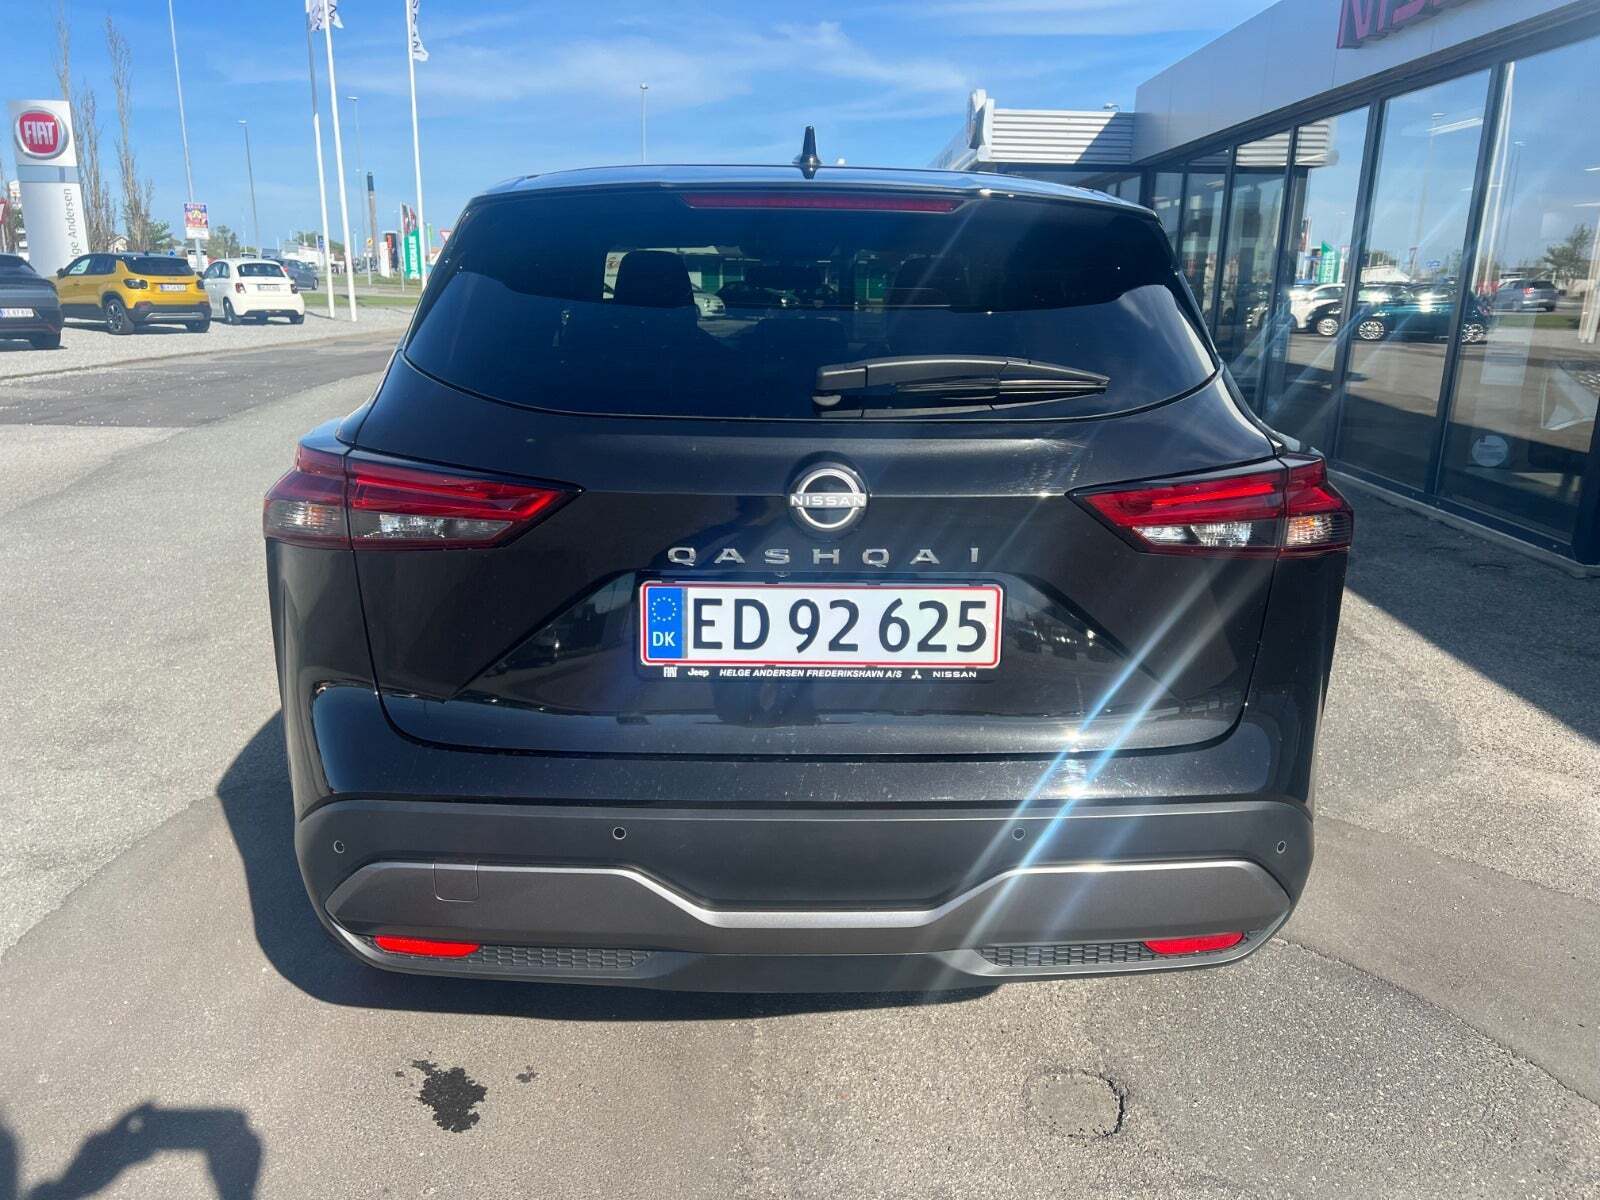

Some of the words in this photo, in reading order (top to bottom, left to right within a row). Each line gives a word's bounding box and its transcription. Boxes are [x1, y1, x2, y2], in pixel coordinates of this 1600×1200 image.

[23, 120, 55, 145] FIAT
[64, 188, 78, 239] Andersen
[790, 493, 867, 508] NISSAN
[667, 547, 980, 568] QASHQAI
[692, 597, 771, 651] ED
[788, 597, 860, 653] 92
[878, 598, 987, 653] 625
[652, 631, 676, 647] DK
[663, 666, 678, 678] FIAT
[687, 667, 710, 678] Jeep
[719, 668, 751, 678] HELGE
[752, 669, 805, 678] ANDERSEN
[806, 669, 884, 679] FREDERIKSHAVN
[885, 670, 903, 679] A/S
[932, 670, 978, 679] NISSAN
